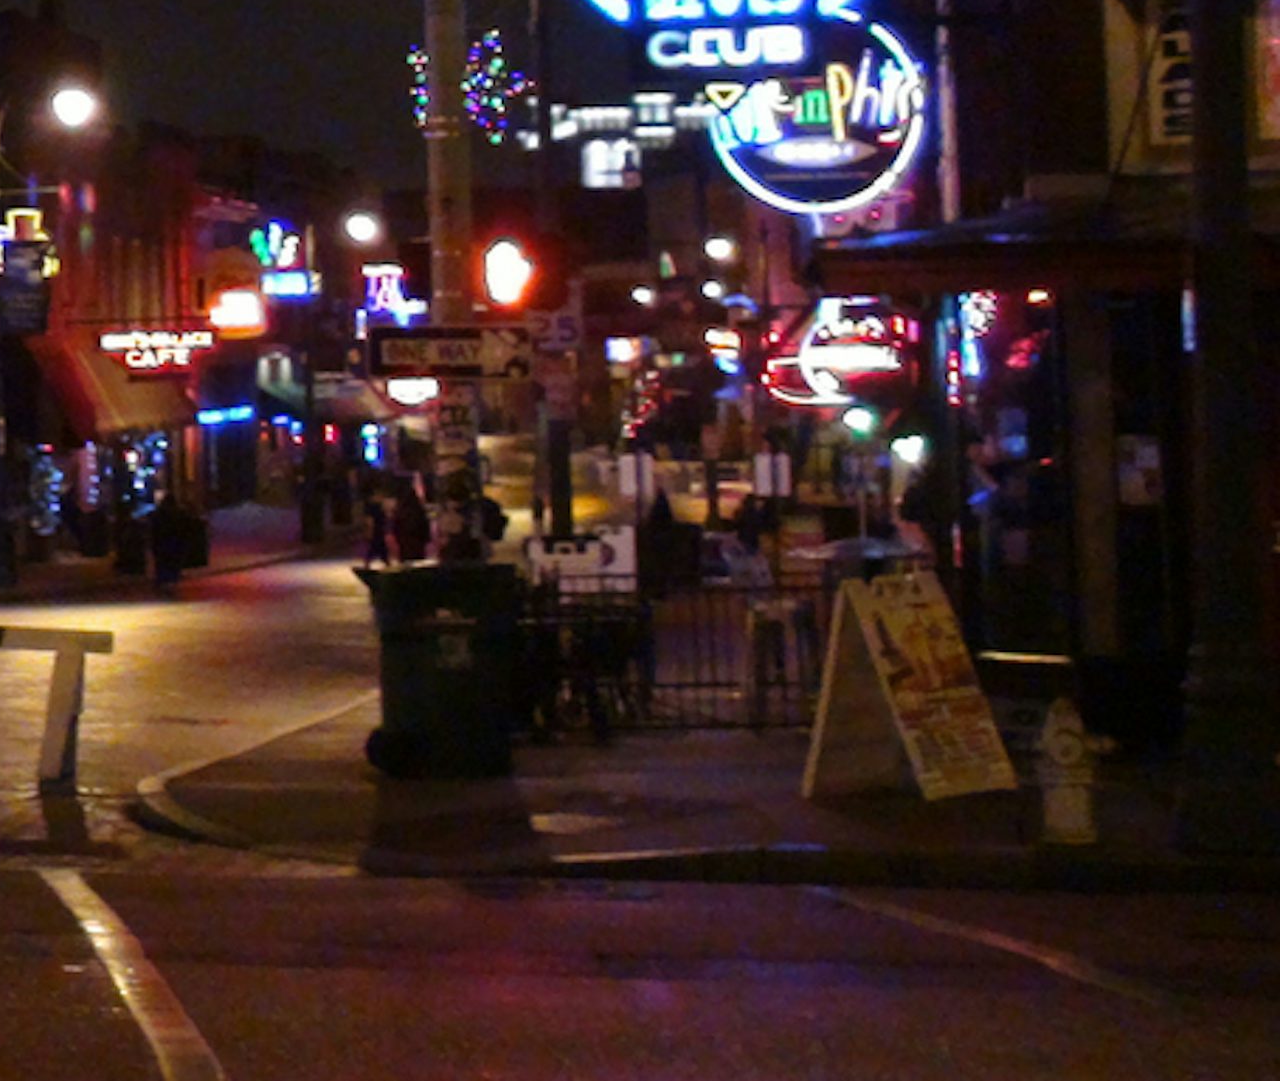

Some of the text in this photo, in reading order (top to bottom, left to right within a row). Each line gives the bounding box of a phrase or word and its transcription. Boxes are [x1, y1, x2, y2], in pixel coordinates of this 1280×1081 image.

[648, 25, 803, 66] CLUB
[124, 348, 189, 367] CAFE
[387, 341, 481, 363] ONE WAY
